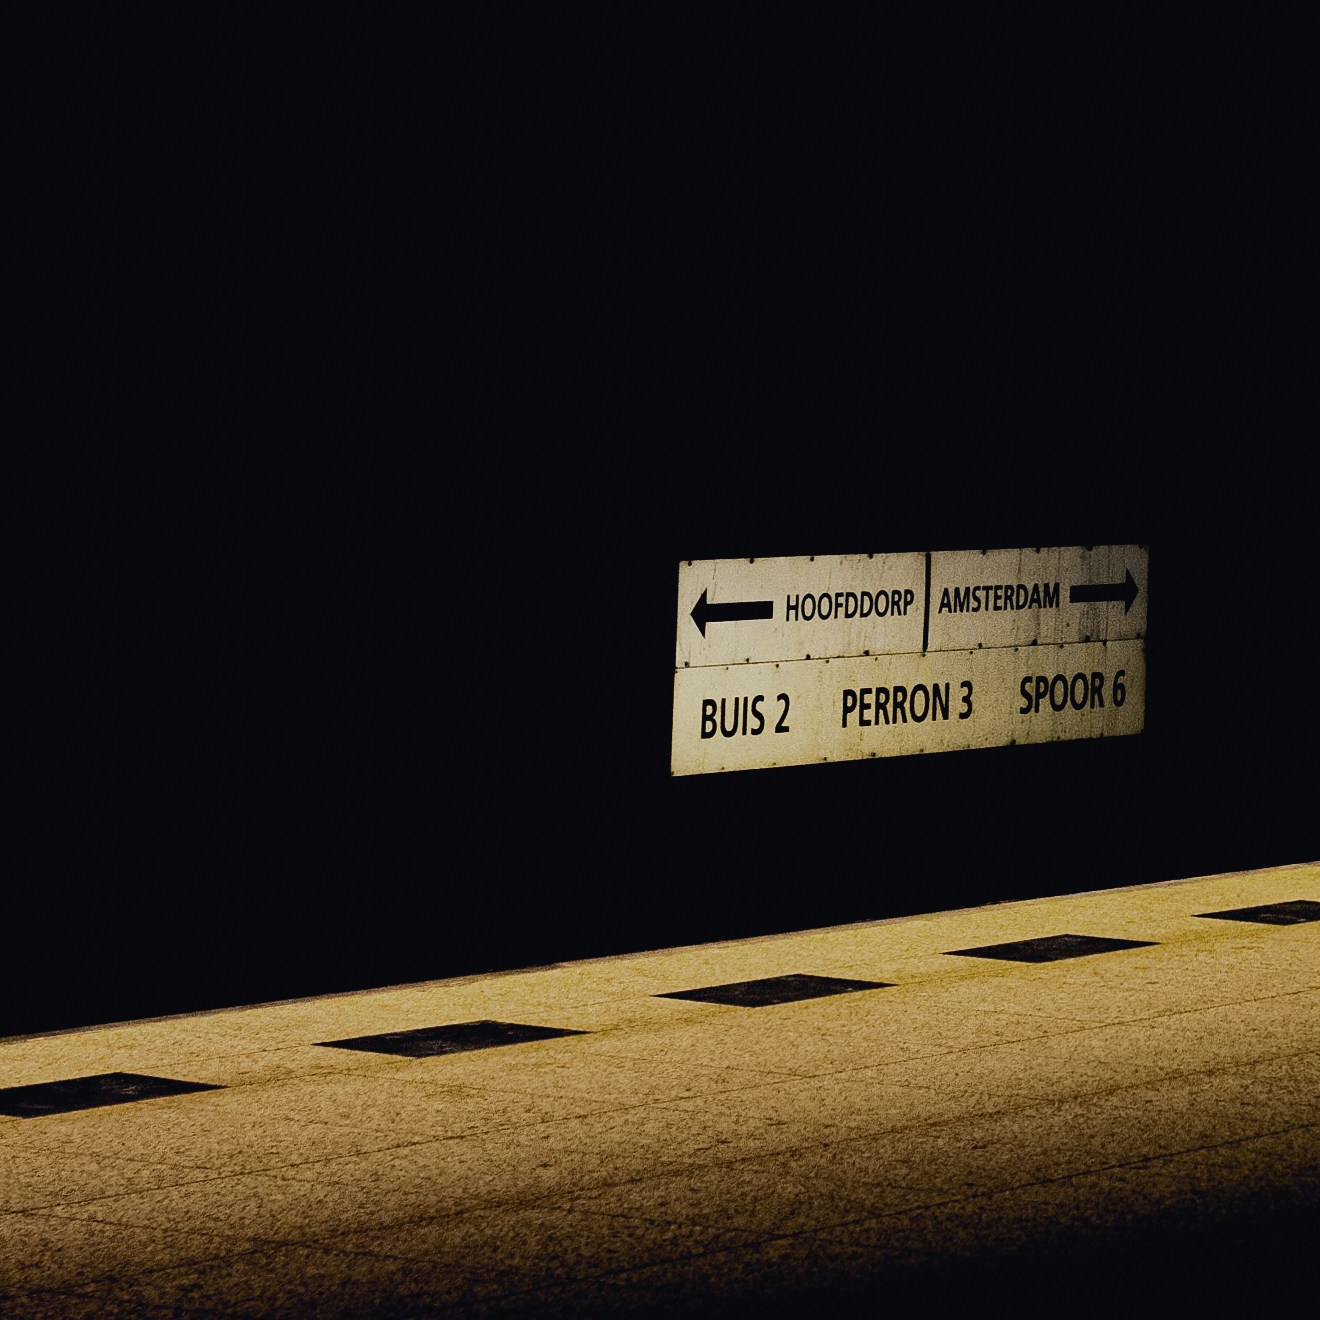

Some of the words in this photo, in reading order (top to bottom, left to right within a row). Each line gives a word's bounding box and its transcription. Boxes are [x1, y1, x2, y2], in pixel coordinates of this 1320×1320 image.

[785, 588, 915, 622] HOOFDDORP
[938, 582, 1061, 615] AMSTERDAM
[841, 682, 951, 729] PERRON
[958, 680, 974, 720] 3
[1019, 673, 1106, 715] SPOOR
[1112, 669, 1127, 708] 6
[700, 694, 766, 740] BUIS
[774, 692, 791, 734] 2
